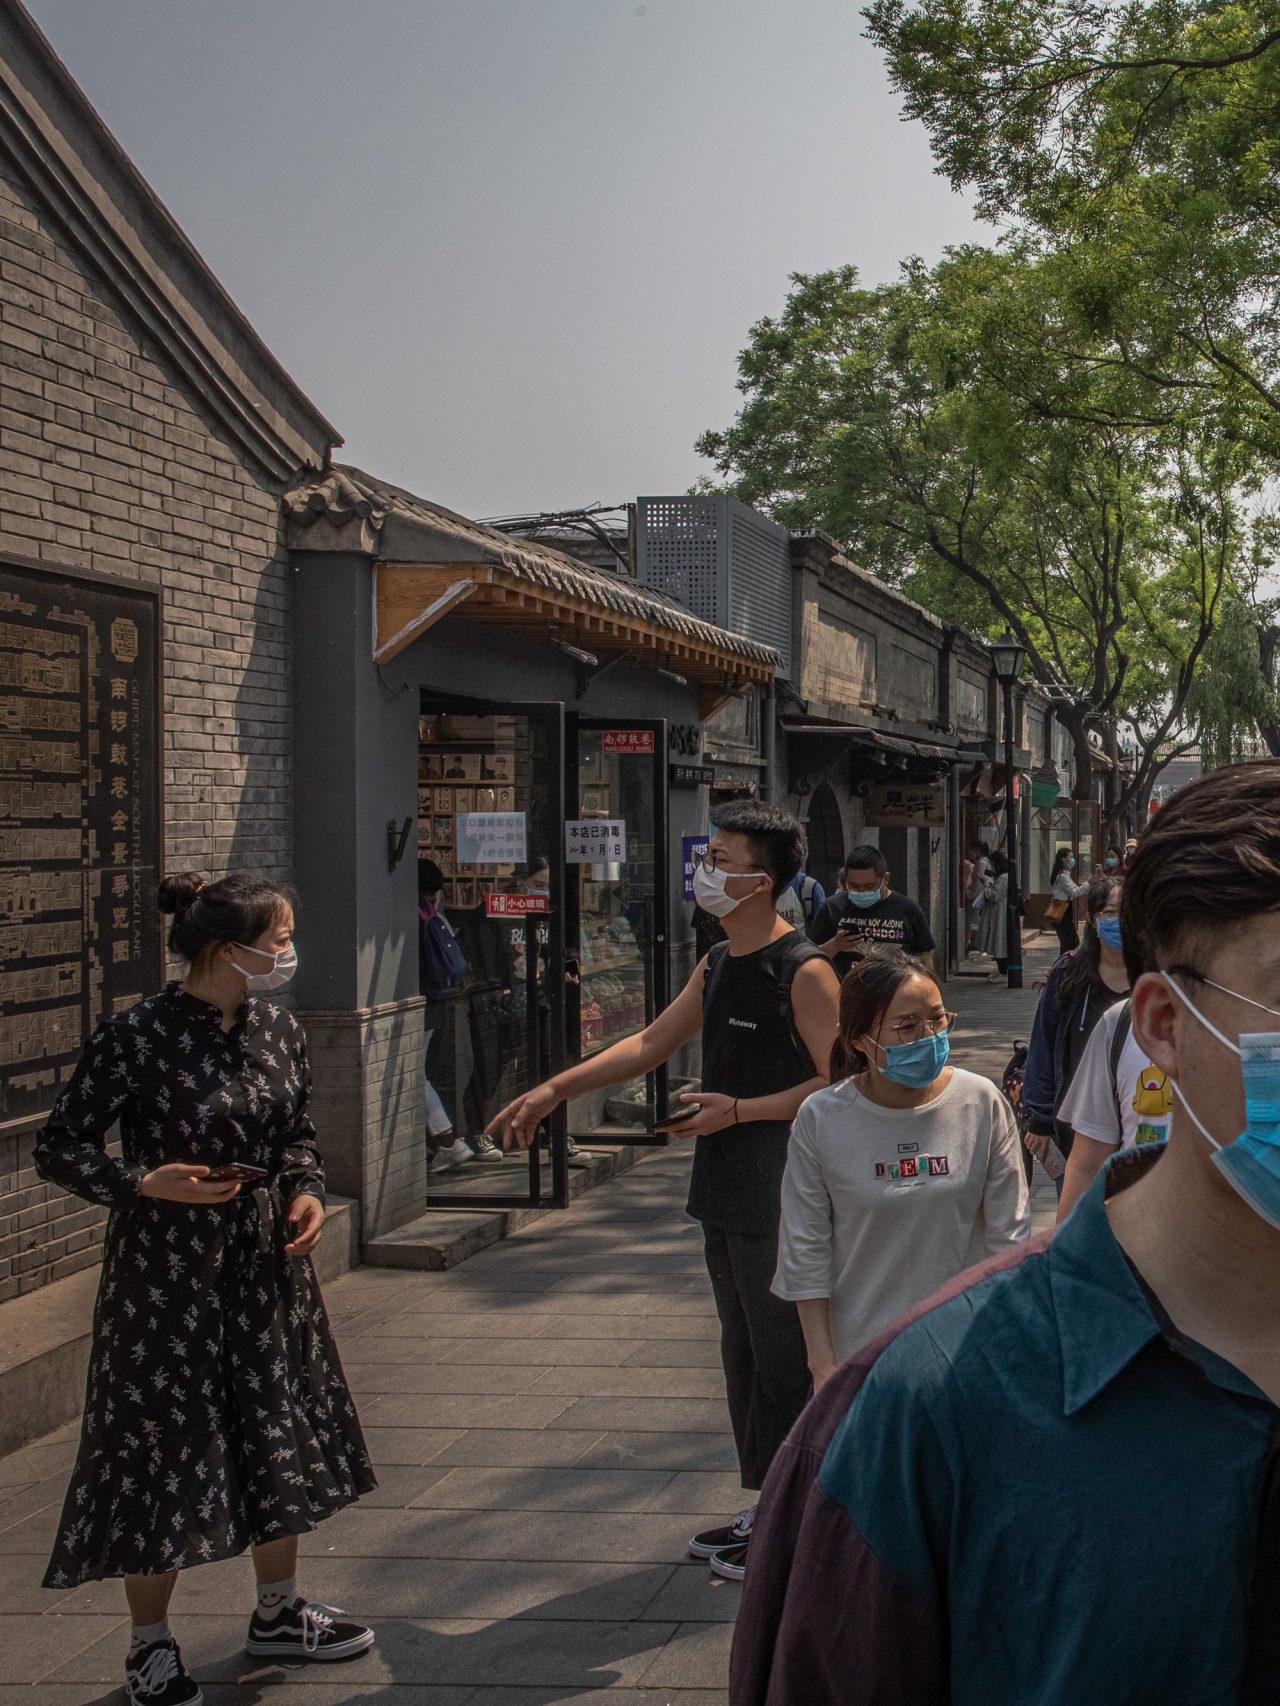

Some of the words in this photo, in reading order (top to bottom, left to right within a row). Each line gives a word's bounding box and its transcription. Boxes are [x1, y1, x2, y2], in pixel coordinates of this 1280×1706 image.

[604, 733, 652, 745] 南锣鼓巷
[132, 798, 140, 855] SOUTH
[570, 825, 620, 838] 本店已消毒
[132, 859, 141, 915] LUOGU
[507, 898, 545, 909] 小心玻璃
[132, 920, 141, 960] LANE
